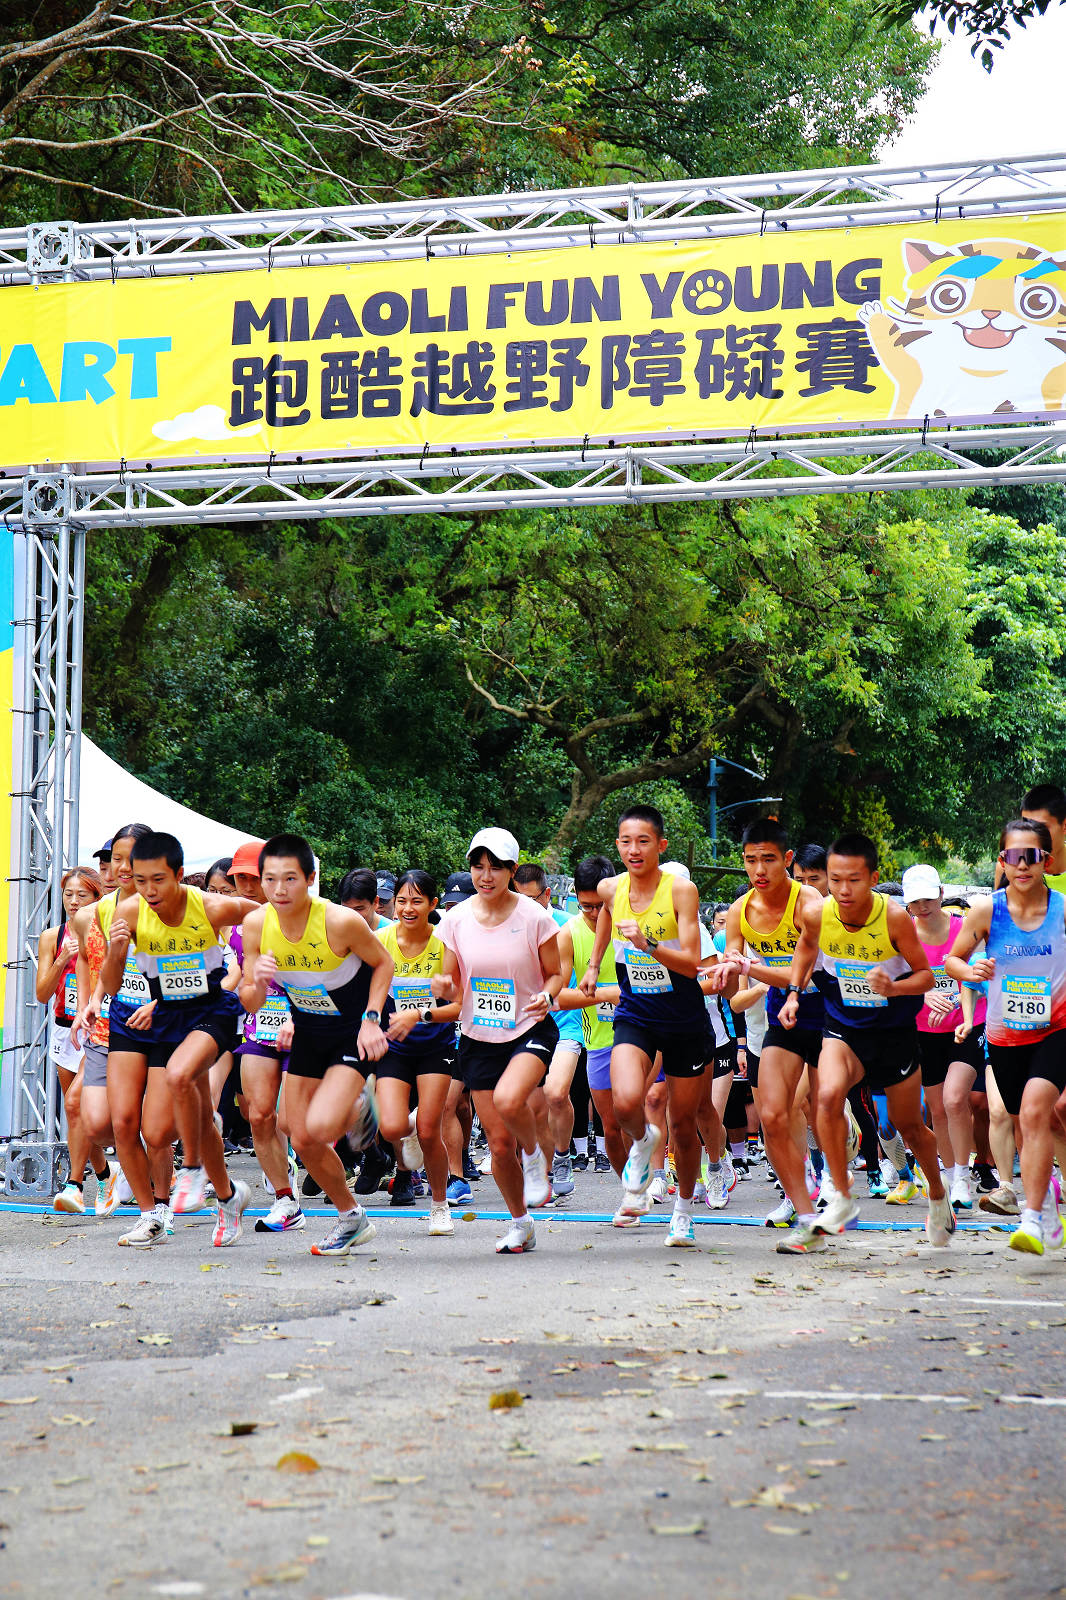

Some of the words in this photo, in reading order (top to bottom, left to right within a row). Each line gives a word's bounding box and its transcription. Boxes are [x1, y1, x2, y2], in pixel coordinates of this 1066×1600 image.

[232, 286, 469, 345] MIAOLI
[486, 275, 621, 330] FUN
[640, 258, 882, 319] YOUNG
[0, 337, 172, 406] ART
[229, 317, 880, 427] 跑酷越野障礙賽
[1004, 944, 1052, 956] TAIWAN
[632, 970, 665, 981] 2058
[166, 976, 202, 989] 2055
[844, 983, 879, 995] 205
[935, 980, 954, 989] 067
[295, 997, 330, 1007] 2056
[478, 998, 511, 1012] 2160
[1007, 999, 1046, 1015] 2180
